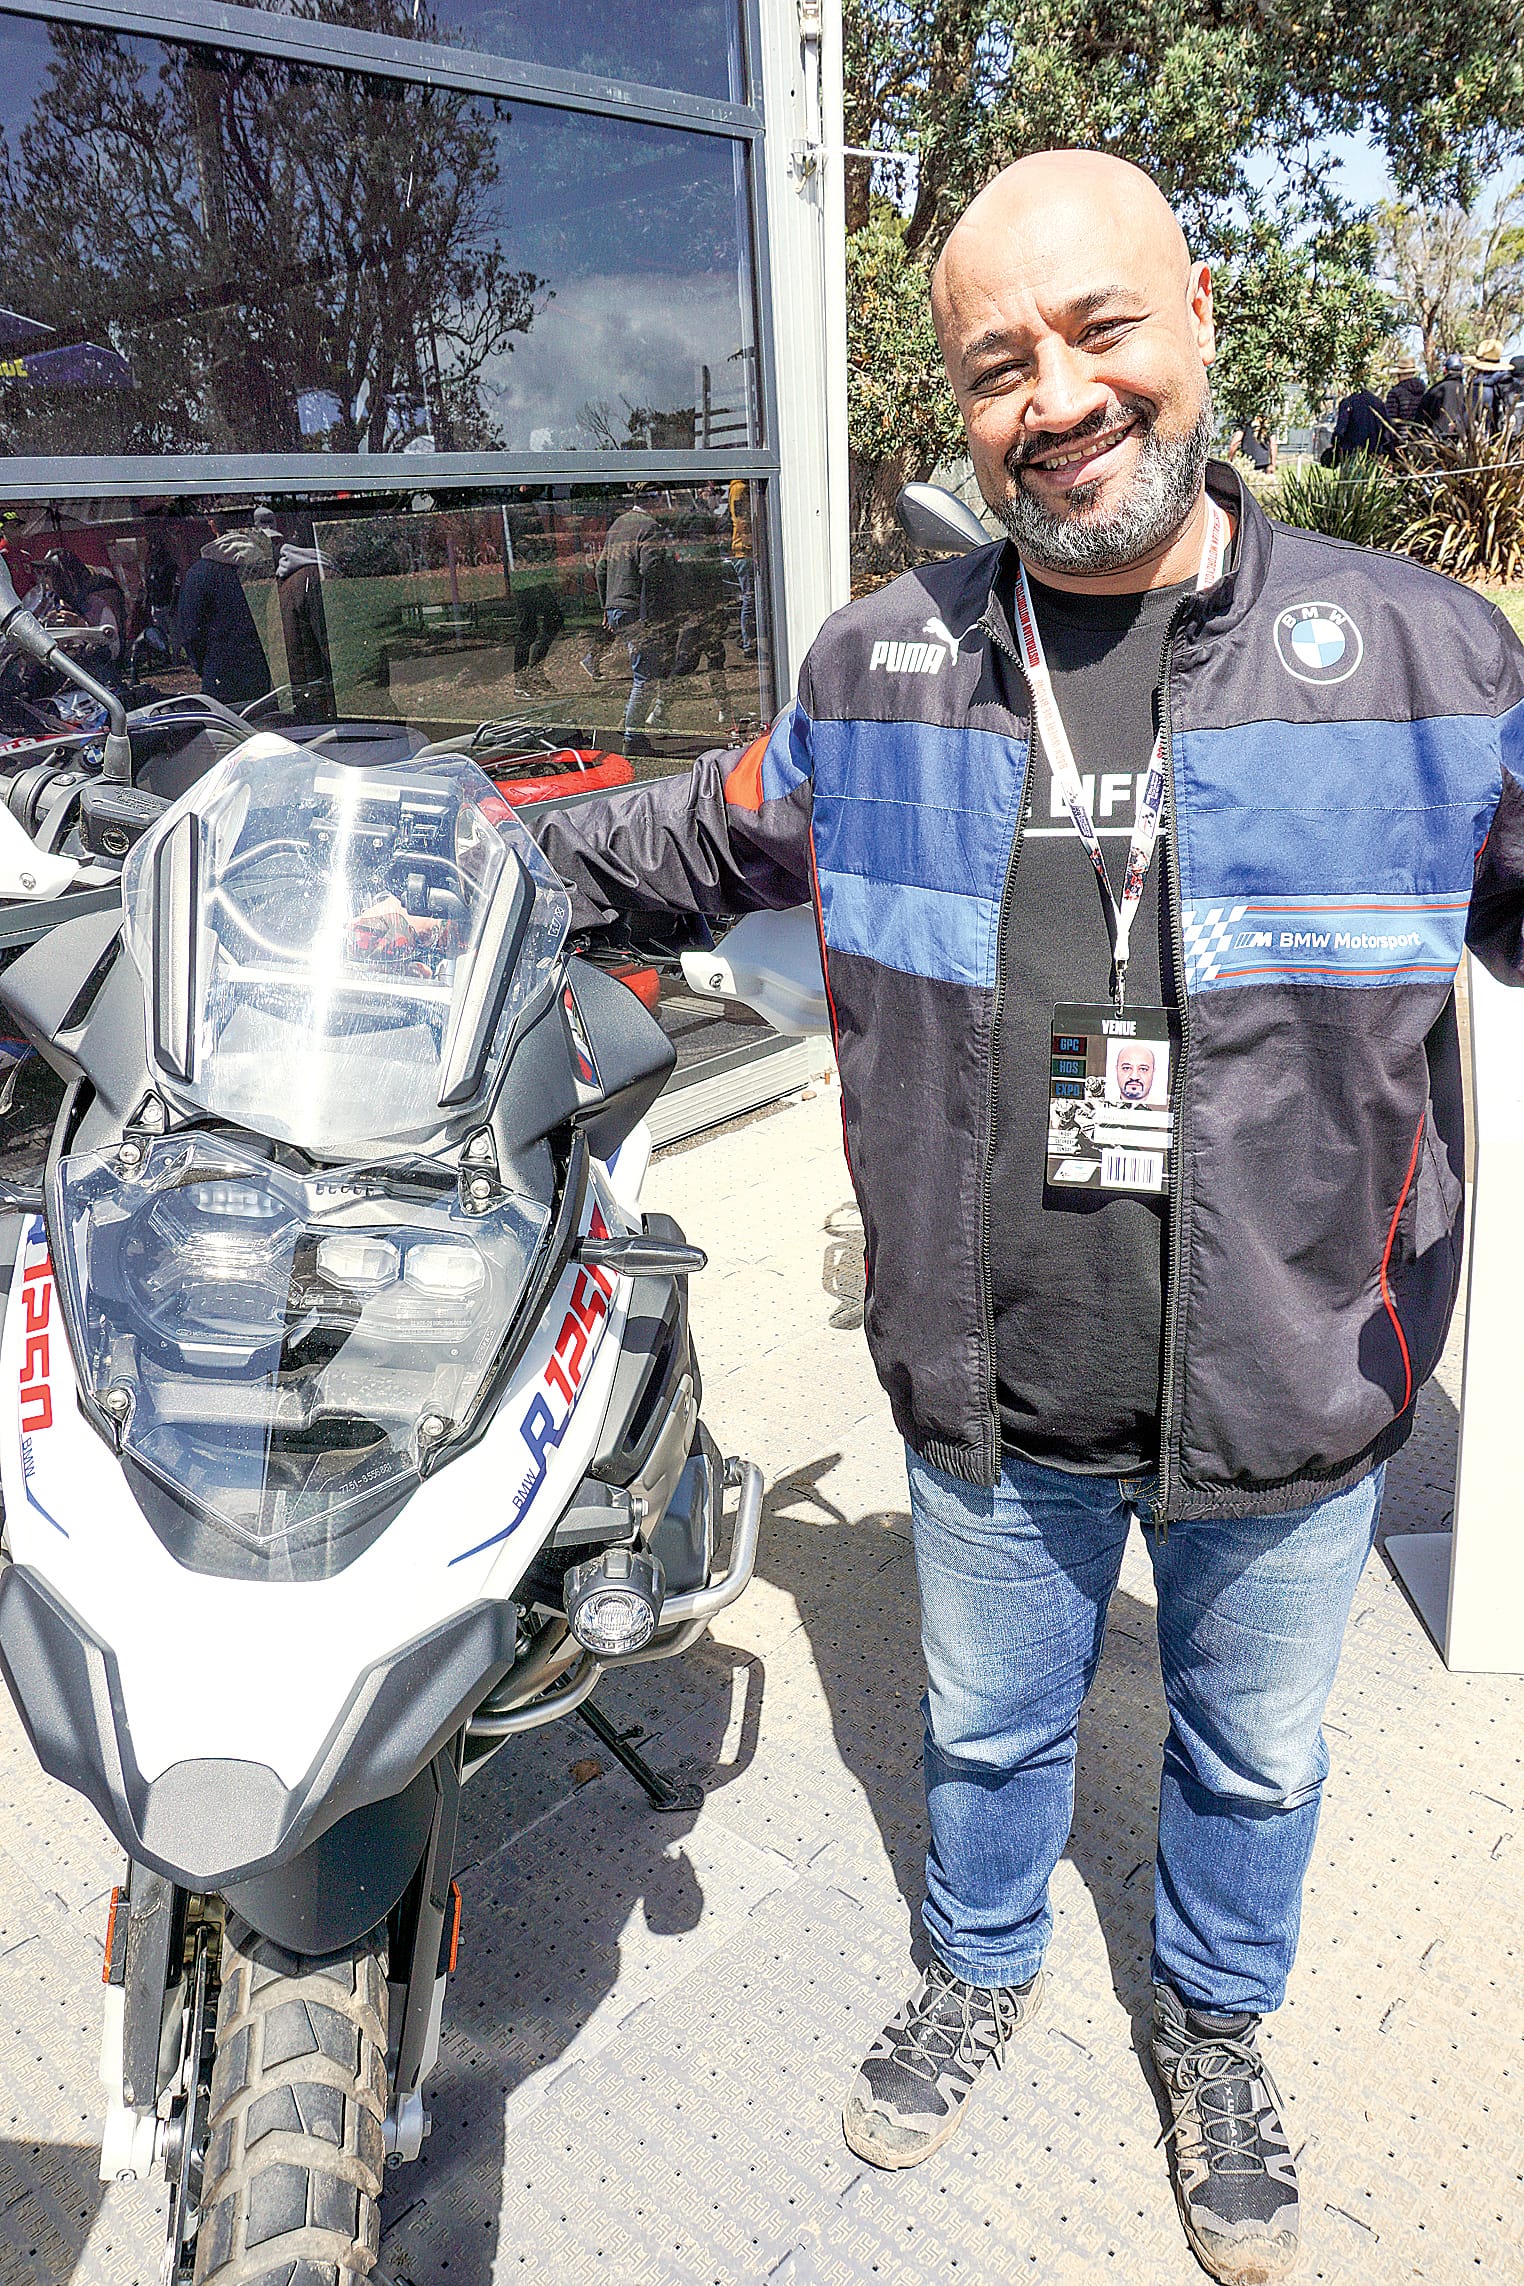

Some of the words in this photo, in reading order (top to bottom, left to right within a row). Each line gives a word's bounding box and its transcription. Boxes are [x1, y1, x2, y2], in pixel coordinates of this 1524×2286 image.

[1281, 606, 1347, 629] BMW
[1022, 623, 1040, 668] AUSTRALIAN
[869, 640, 947, 675] PUMA
[1280, 932, 1330, 948] BMW
[1334, 931, 1421, 949] Motorsport
[1101, 1019, 1137, 1036] VENUE
[1059, 1037, 1080, 1052] GPC
[1059, 1061, 1079, 1074] HOS
[1055, 1082, 1080, 1097] EXPO
[519, 1391, 566, 1470] R
[22, 1436, 36, 1479] BMW
[512, 1467, 538, 1510] BMW
